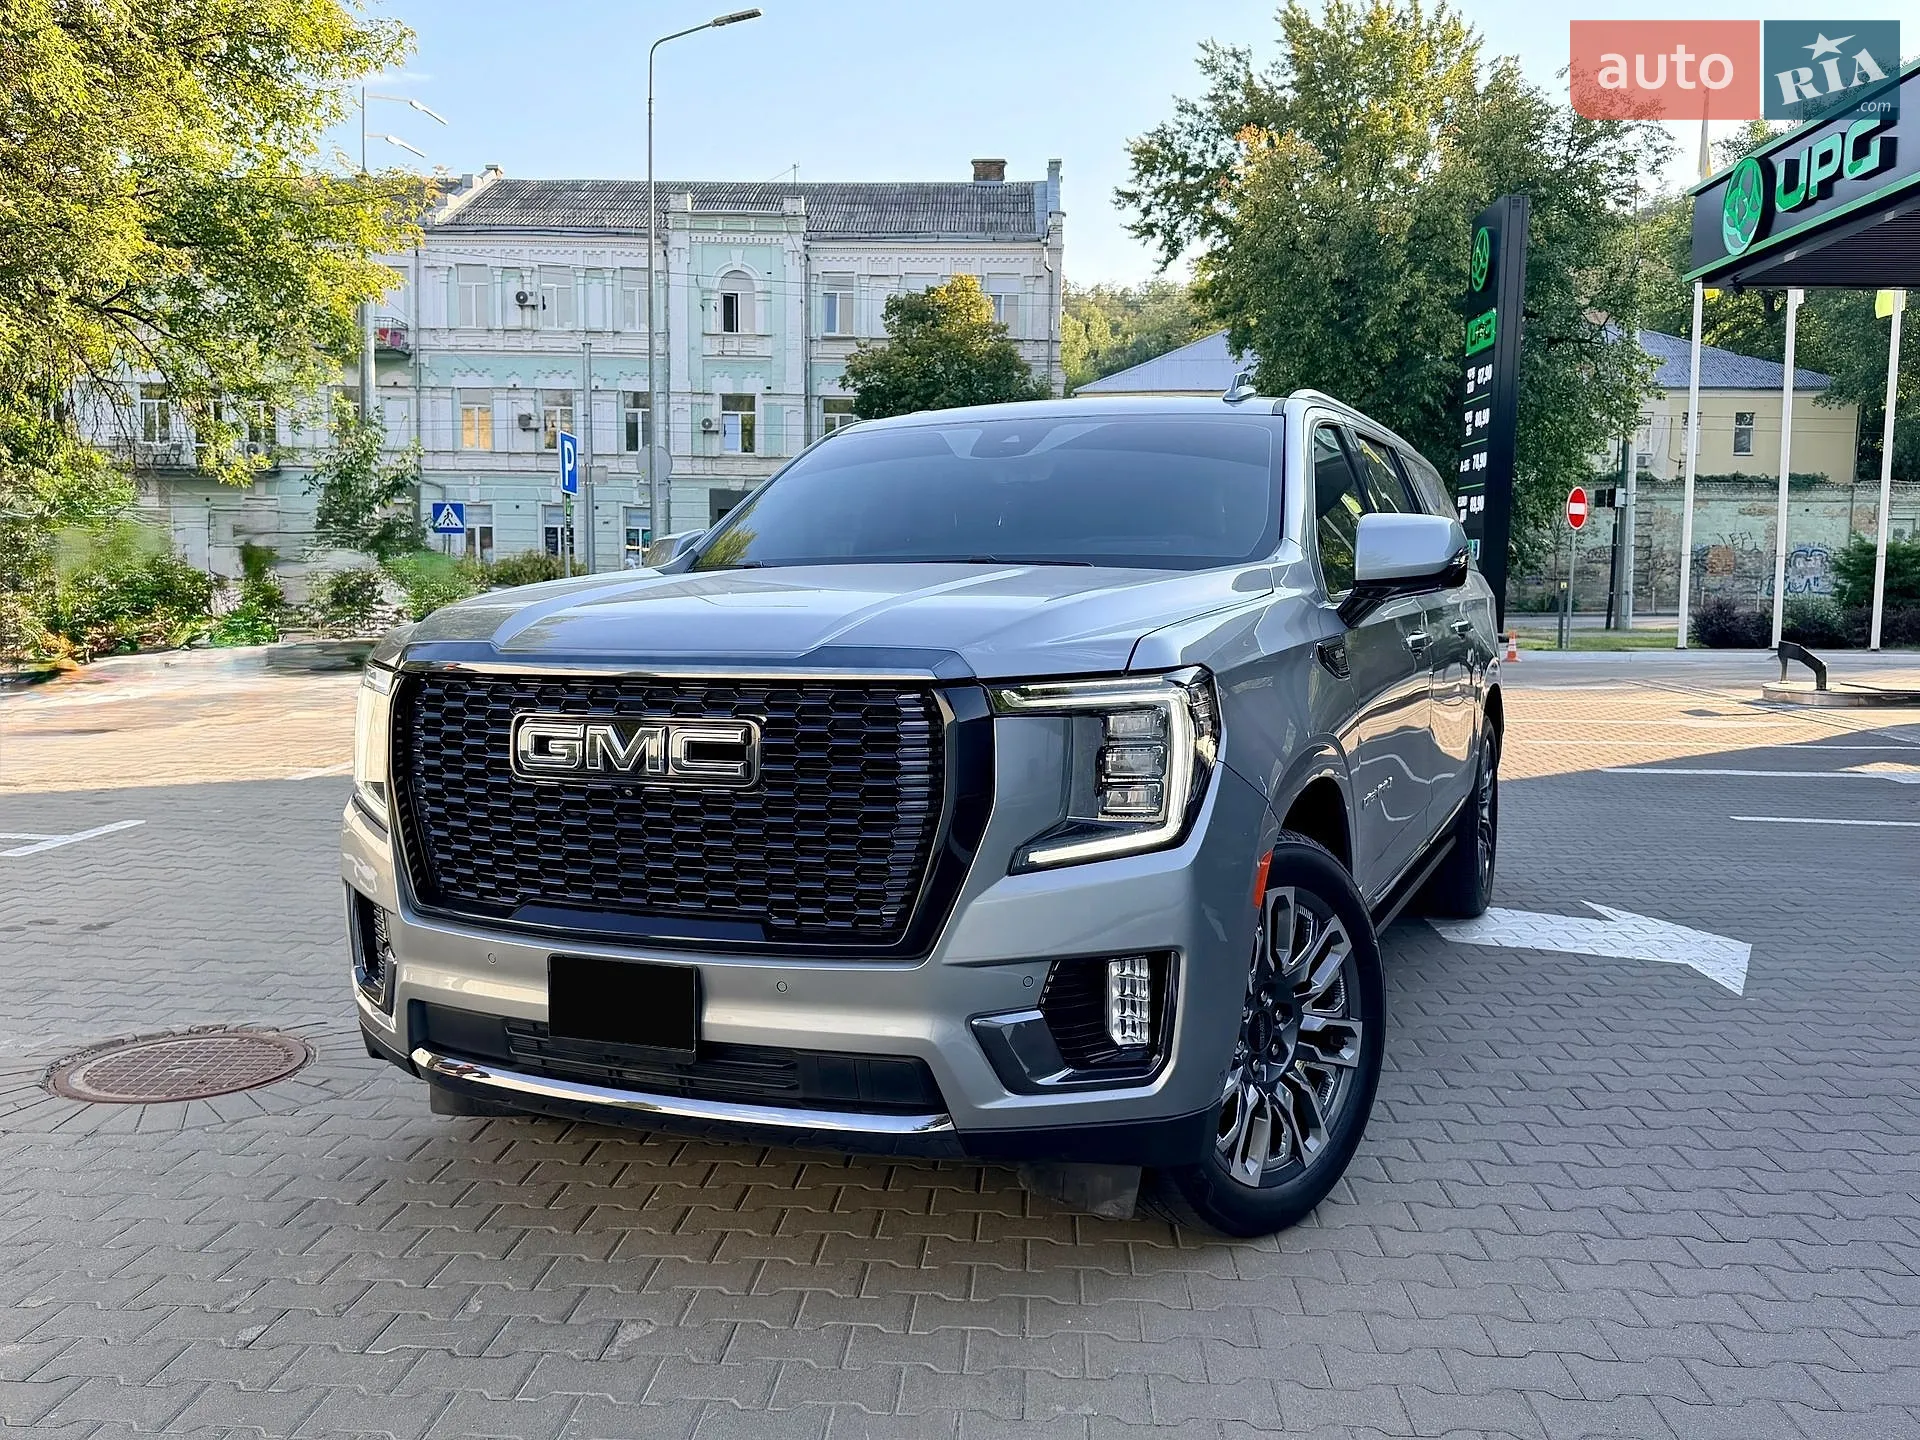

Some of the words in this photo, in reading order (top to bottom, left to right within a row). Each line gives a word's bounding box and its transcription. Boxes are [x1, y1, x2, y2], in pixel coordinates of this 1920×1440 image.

[1775, 110, 1881, 213] UPG
[563, 440, 575, 487] P
[518, 722, 749, 778] GMC
